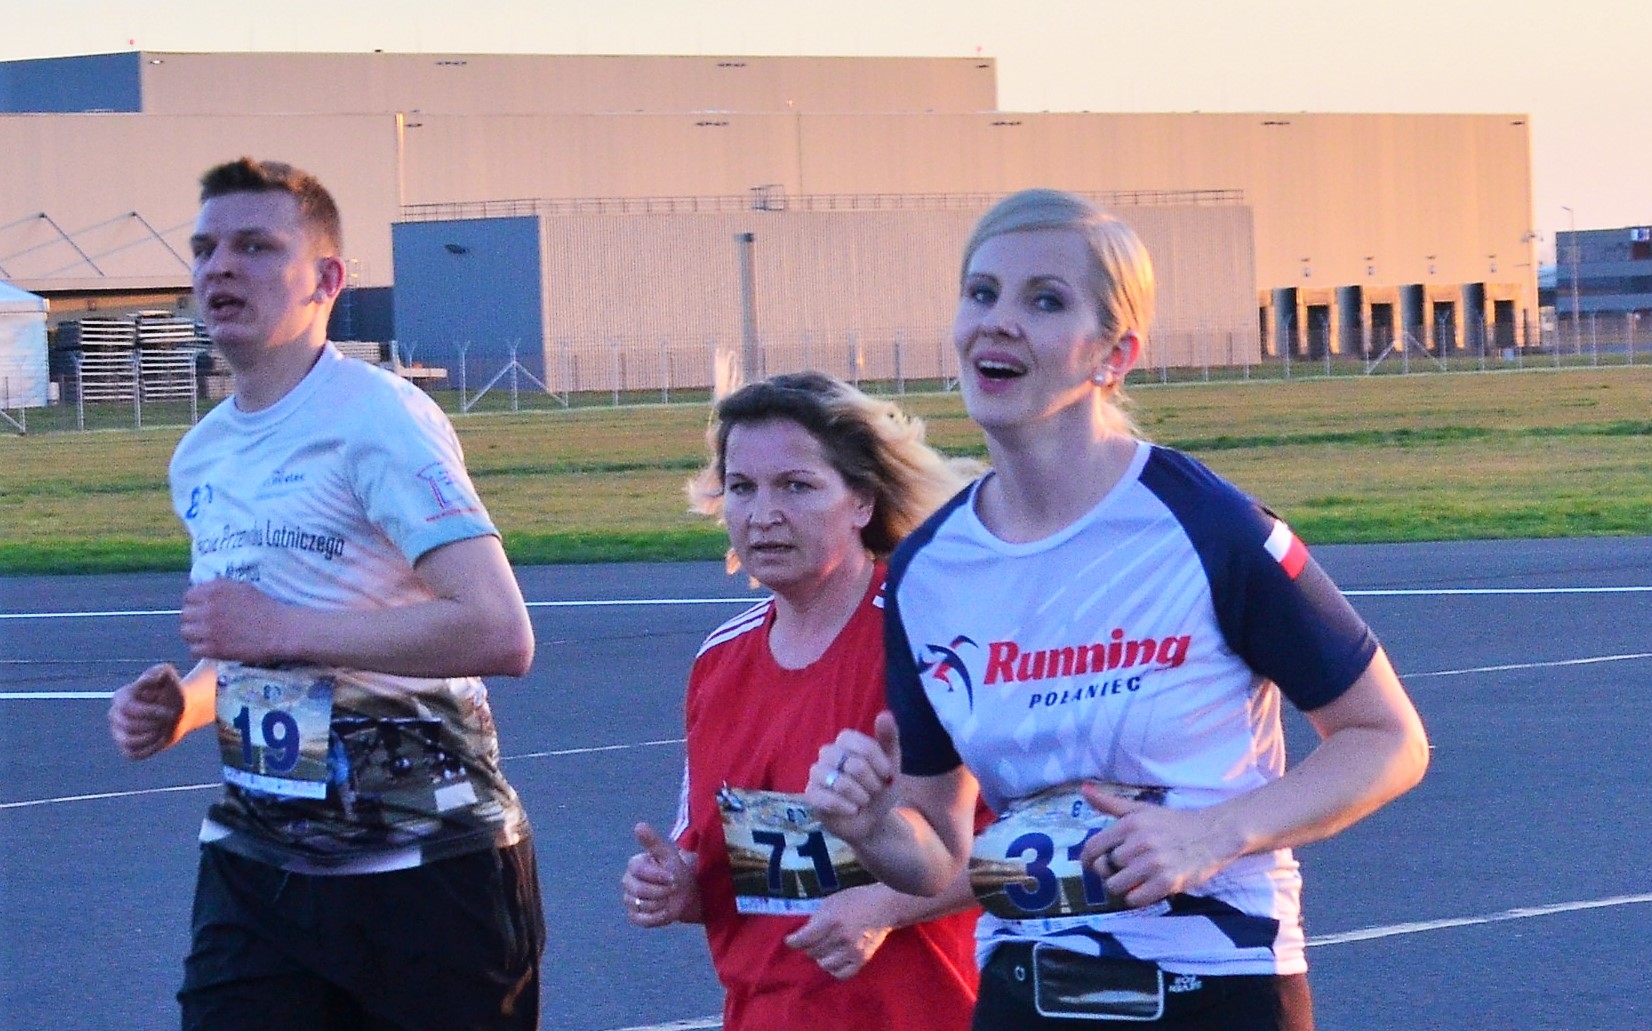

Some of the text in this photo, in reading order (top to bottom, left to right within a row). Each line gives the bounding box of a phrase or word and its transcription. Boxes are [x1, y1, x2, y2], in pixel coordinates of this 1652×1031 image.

[265, 519, 346, 561] Lotniczego
[983, 628, 1192, 685] Running
[1028, 675, 1142, 709] POŁANIEC
[232, 705, 300, 773] 19
[751, 829, 840, 892] 71
